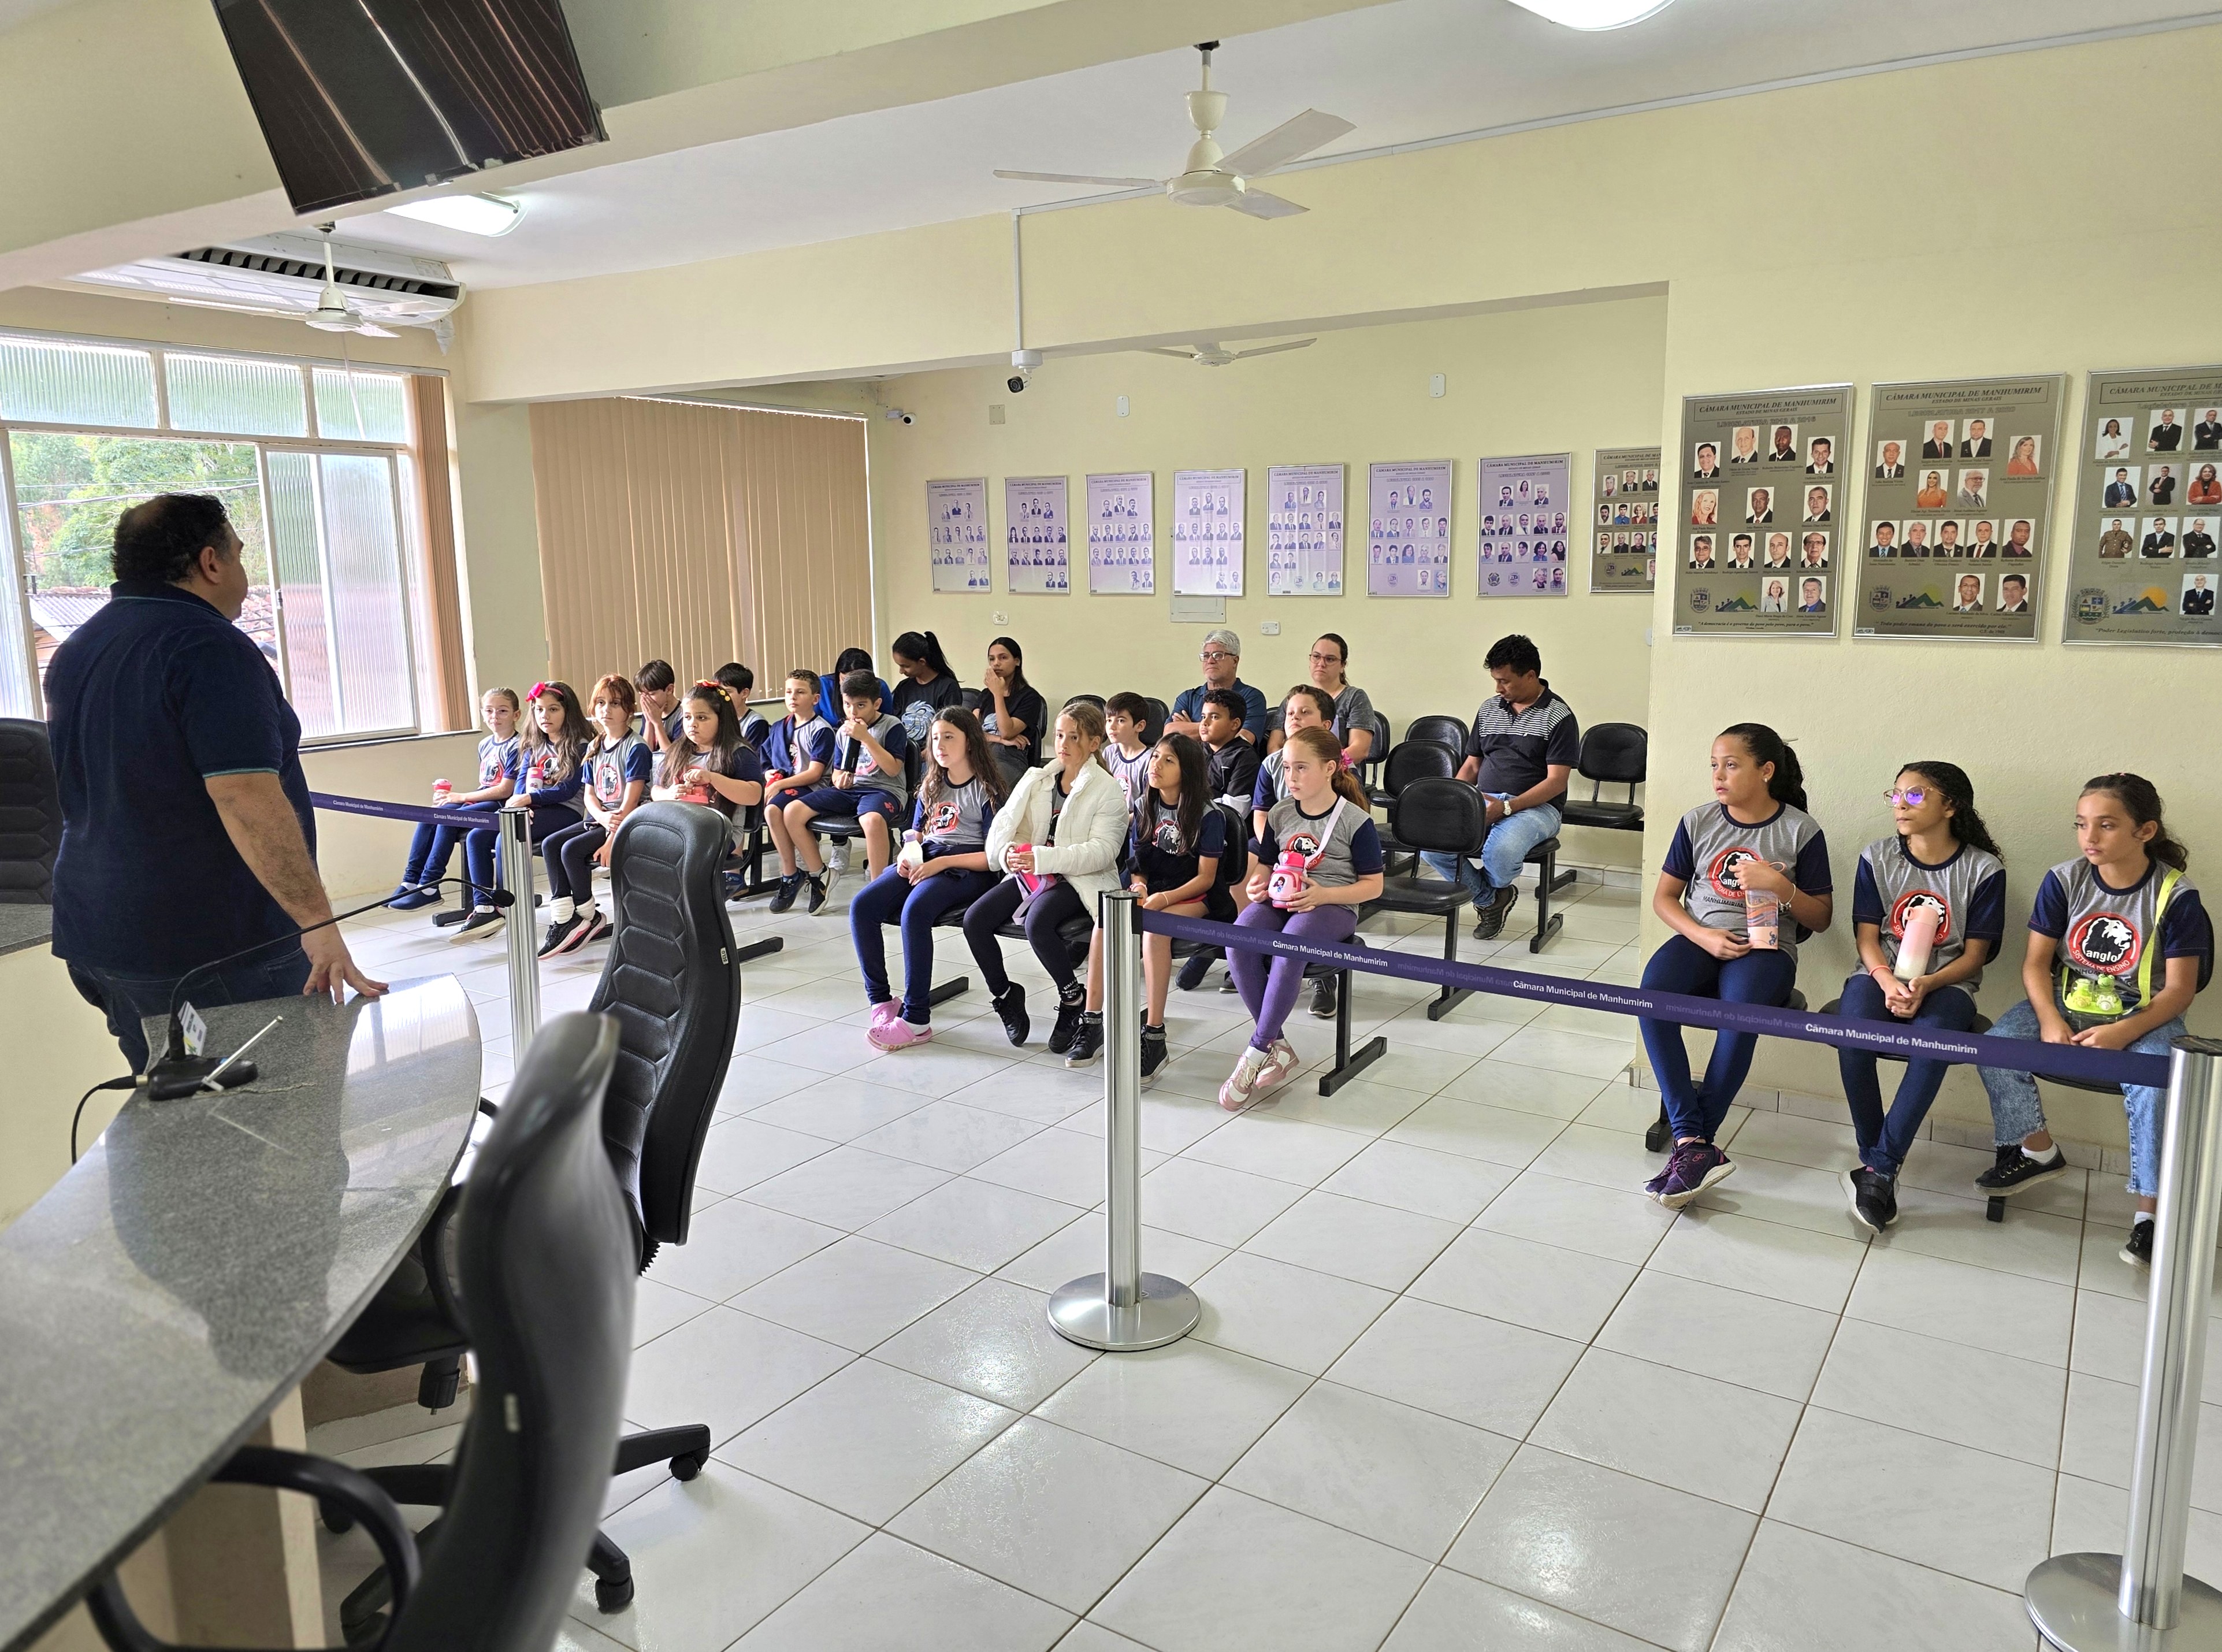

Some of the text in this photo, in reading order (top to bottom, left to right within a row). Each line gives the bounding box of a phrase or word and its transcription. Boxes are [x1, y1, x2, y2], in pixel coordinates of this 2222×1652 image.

[1886, 392, 1919, 401] CÂMARA
[1922, 391, 1966, 399] MUNICIPAL
[1982, 387, 2041, 396] MANHUMIRIM
[1783, 398, 1836, 407] MANHUMIRIM
[1714, 881, 1727, 895] SSTEMA
[1723, 879, 1740, 887] ang
[1273, 940, 1388, 967] Câmara Municipal de Manhumirim
[2086, 951, 2117, 962] anglo
[2073, 950, 2095, 968] SISTEMA
[2106, 960, 2130, 972] ENSINO
[1513, 980, 1653, 1008] Câmara Municipal de Manhumirim
[1805, 1023, 1977, 1056] Câmara Municipal de Manhumirim
